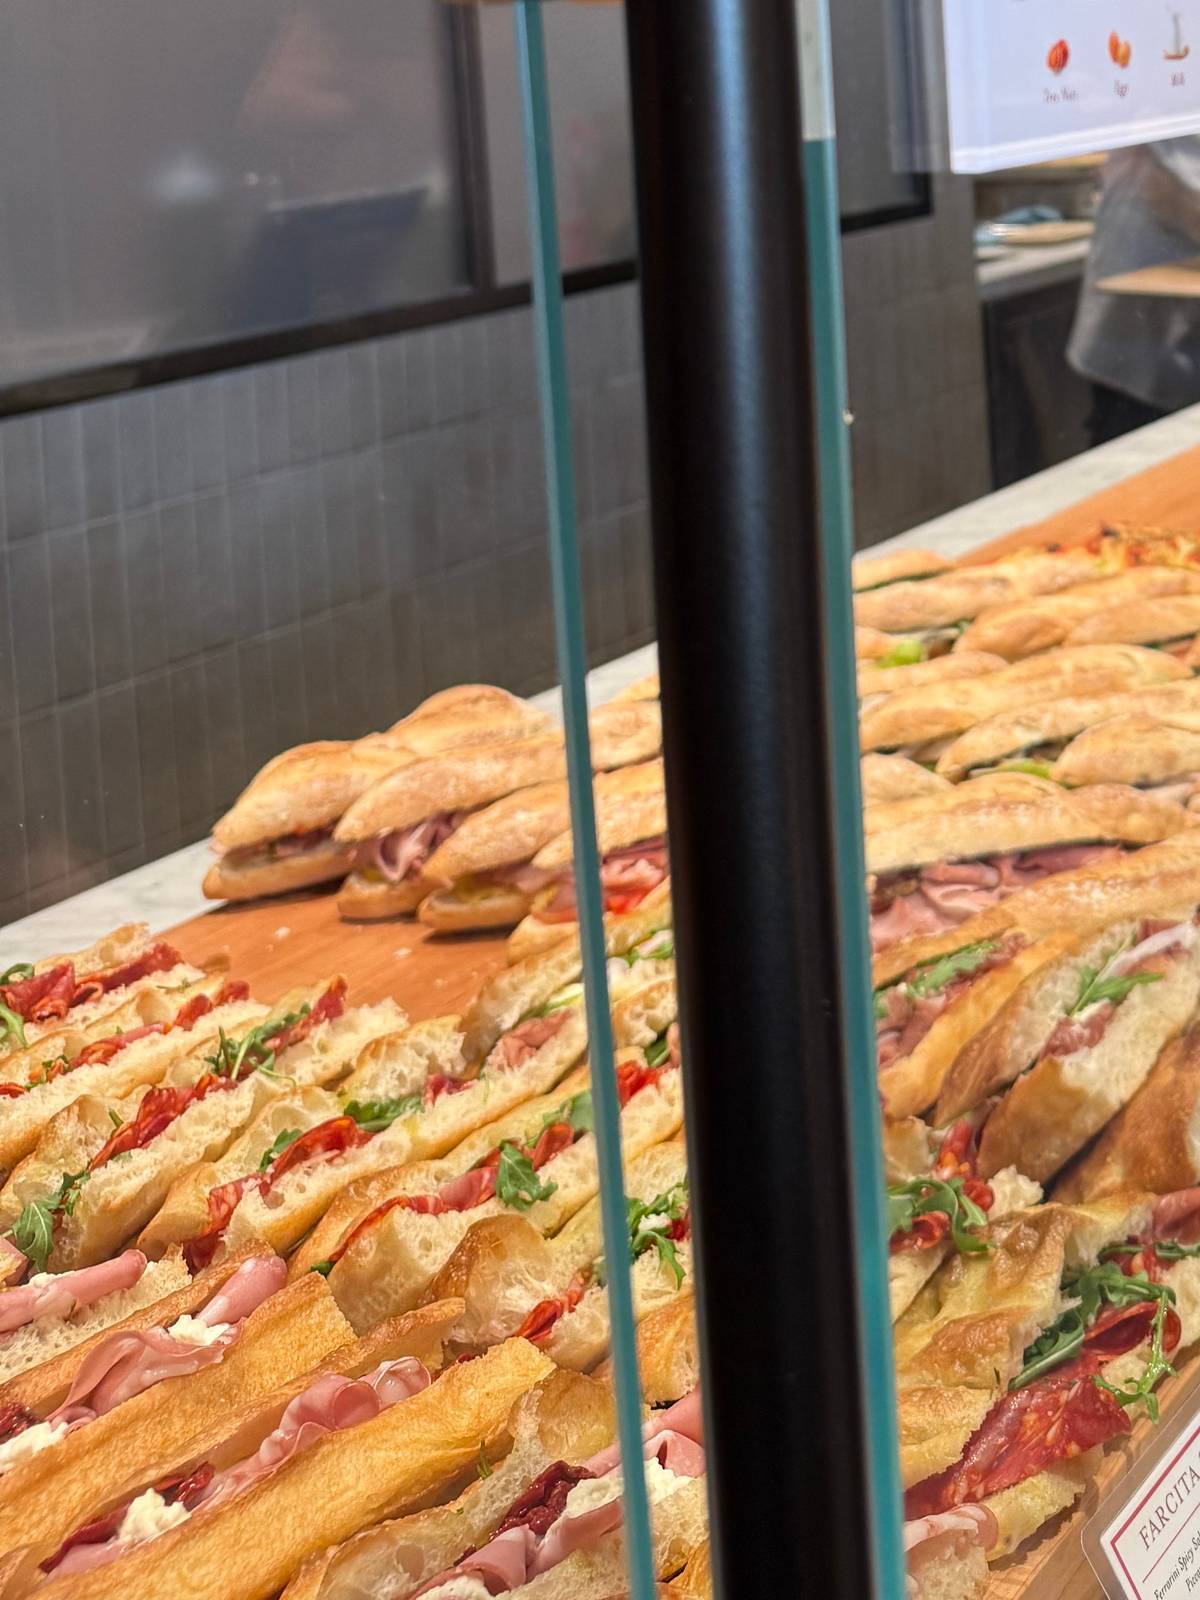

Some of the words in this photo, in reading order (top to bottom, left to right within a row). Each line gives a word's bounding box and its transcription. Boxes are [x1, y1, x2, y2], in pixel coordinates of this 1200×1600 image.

[1139, 1466, 1200, 1549] FARCITA
[1153, 1568, 1179, 1600] Ferrarini
[1177, 1547, 1194, 1571] Spicy
